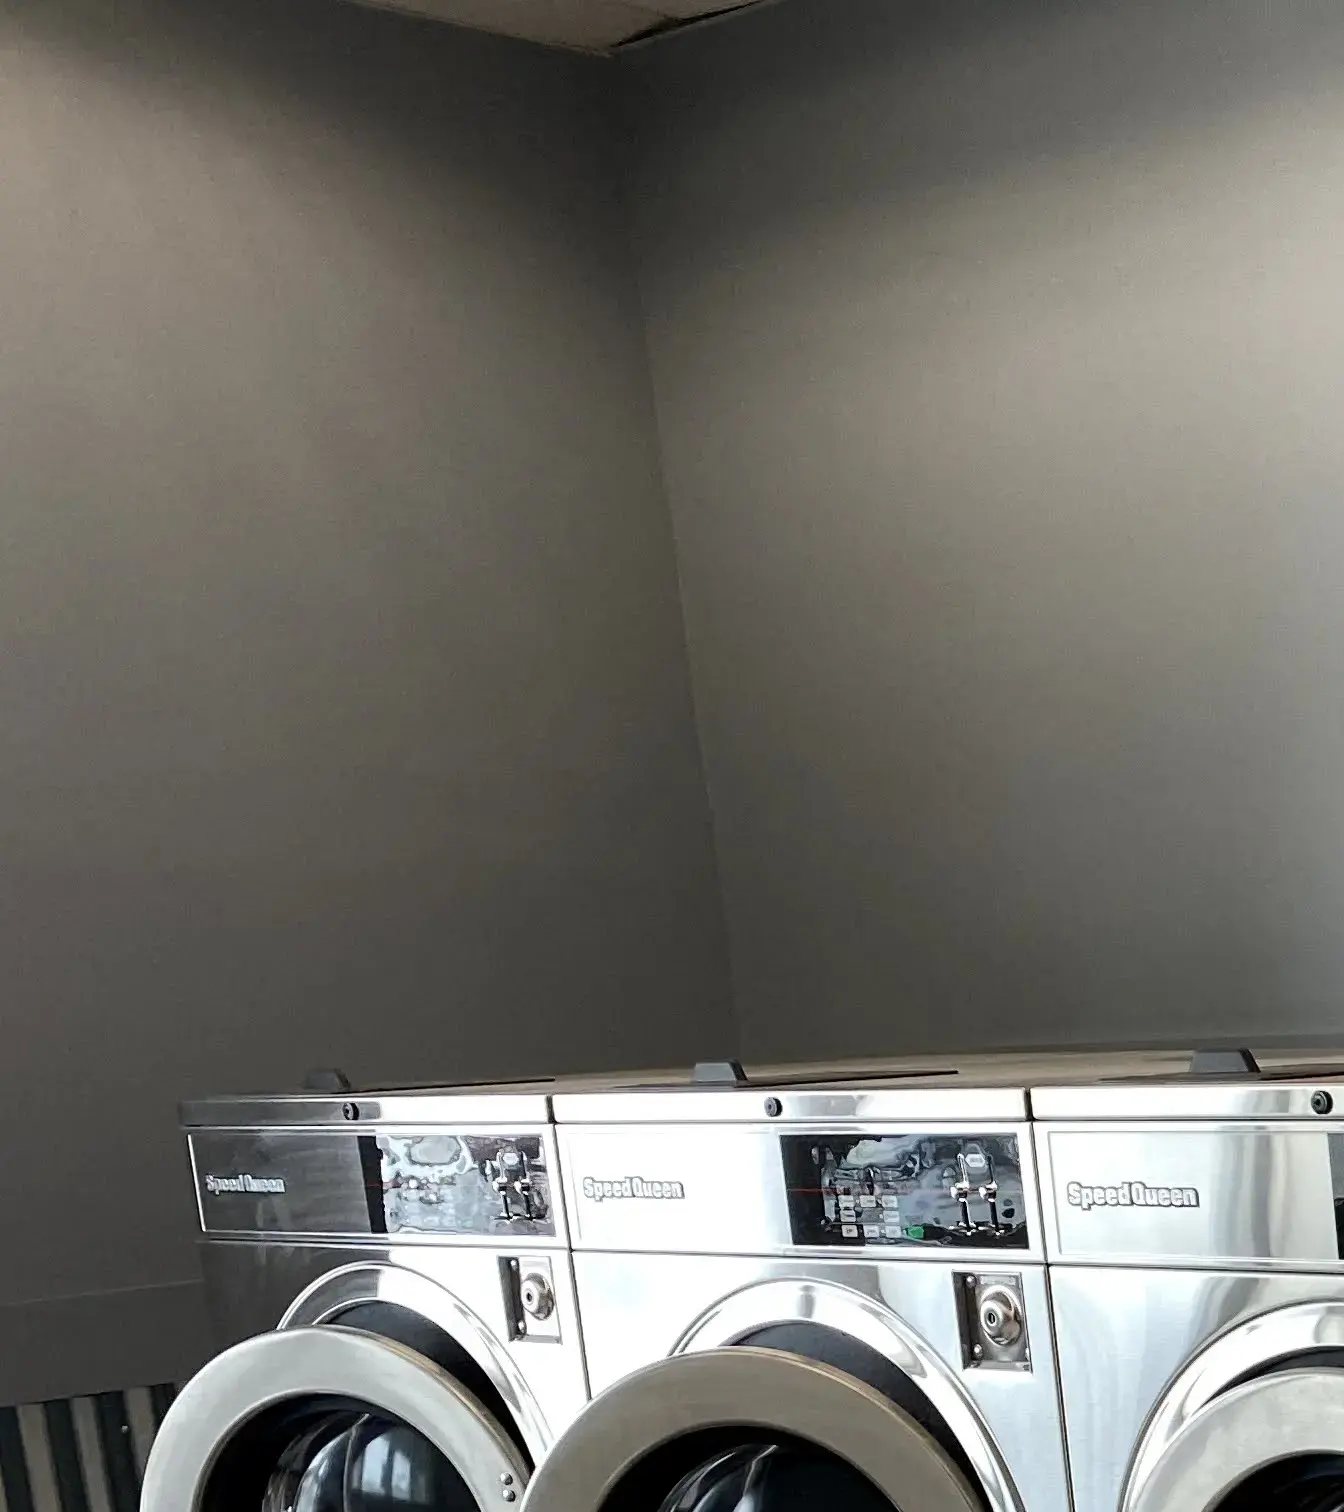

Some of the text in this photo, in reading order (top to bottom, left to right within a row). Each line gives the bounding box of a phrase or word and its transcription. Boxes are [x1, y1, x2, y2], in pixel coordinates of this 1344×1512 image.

[205, 1173, 286, 1196] Speed Queen
[583, 1176, 685, 1203] Speed Queen
[1067, 1181, 1200, 1211] Speed Queen
